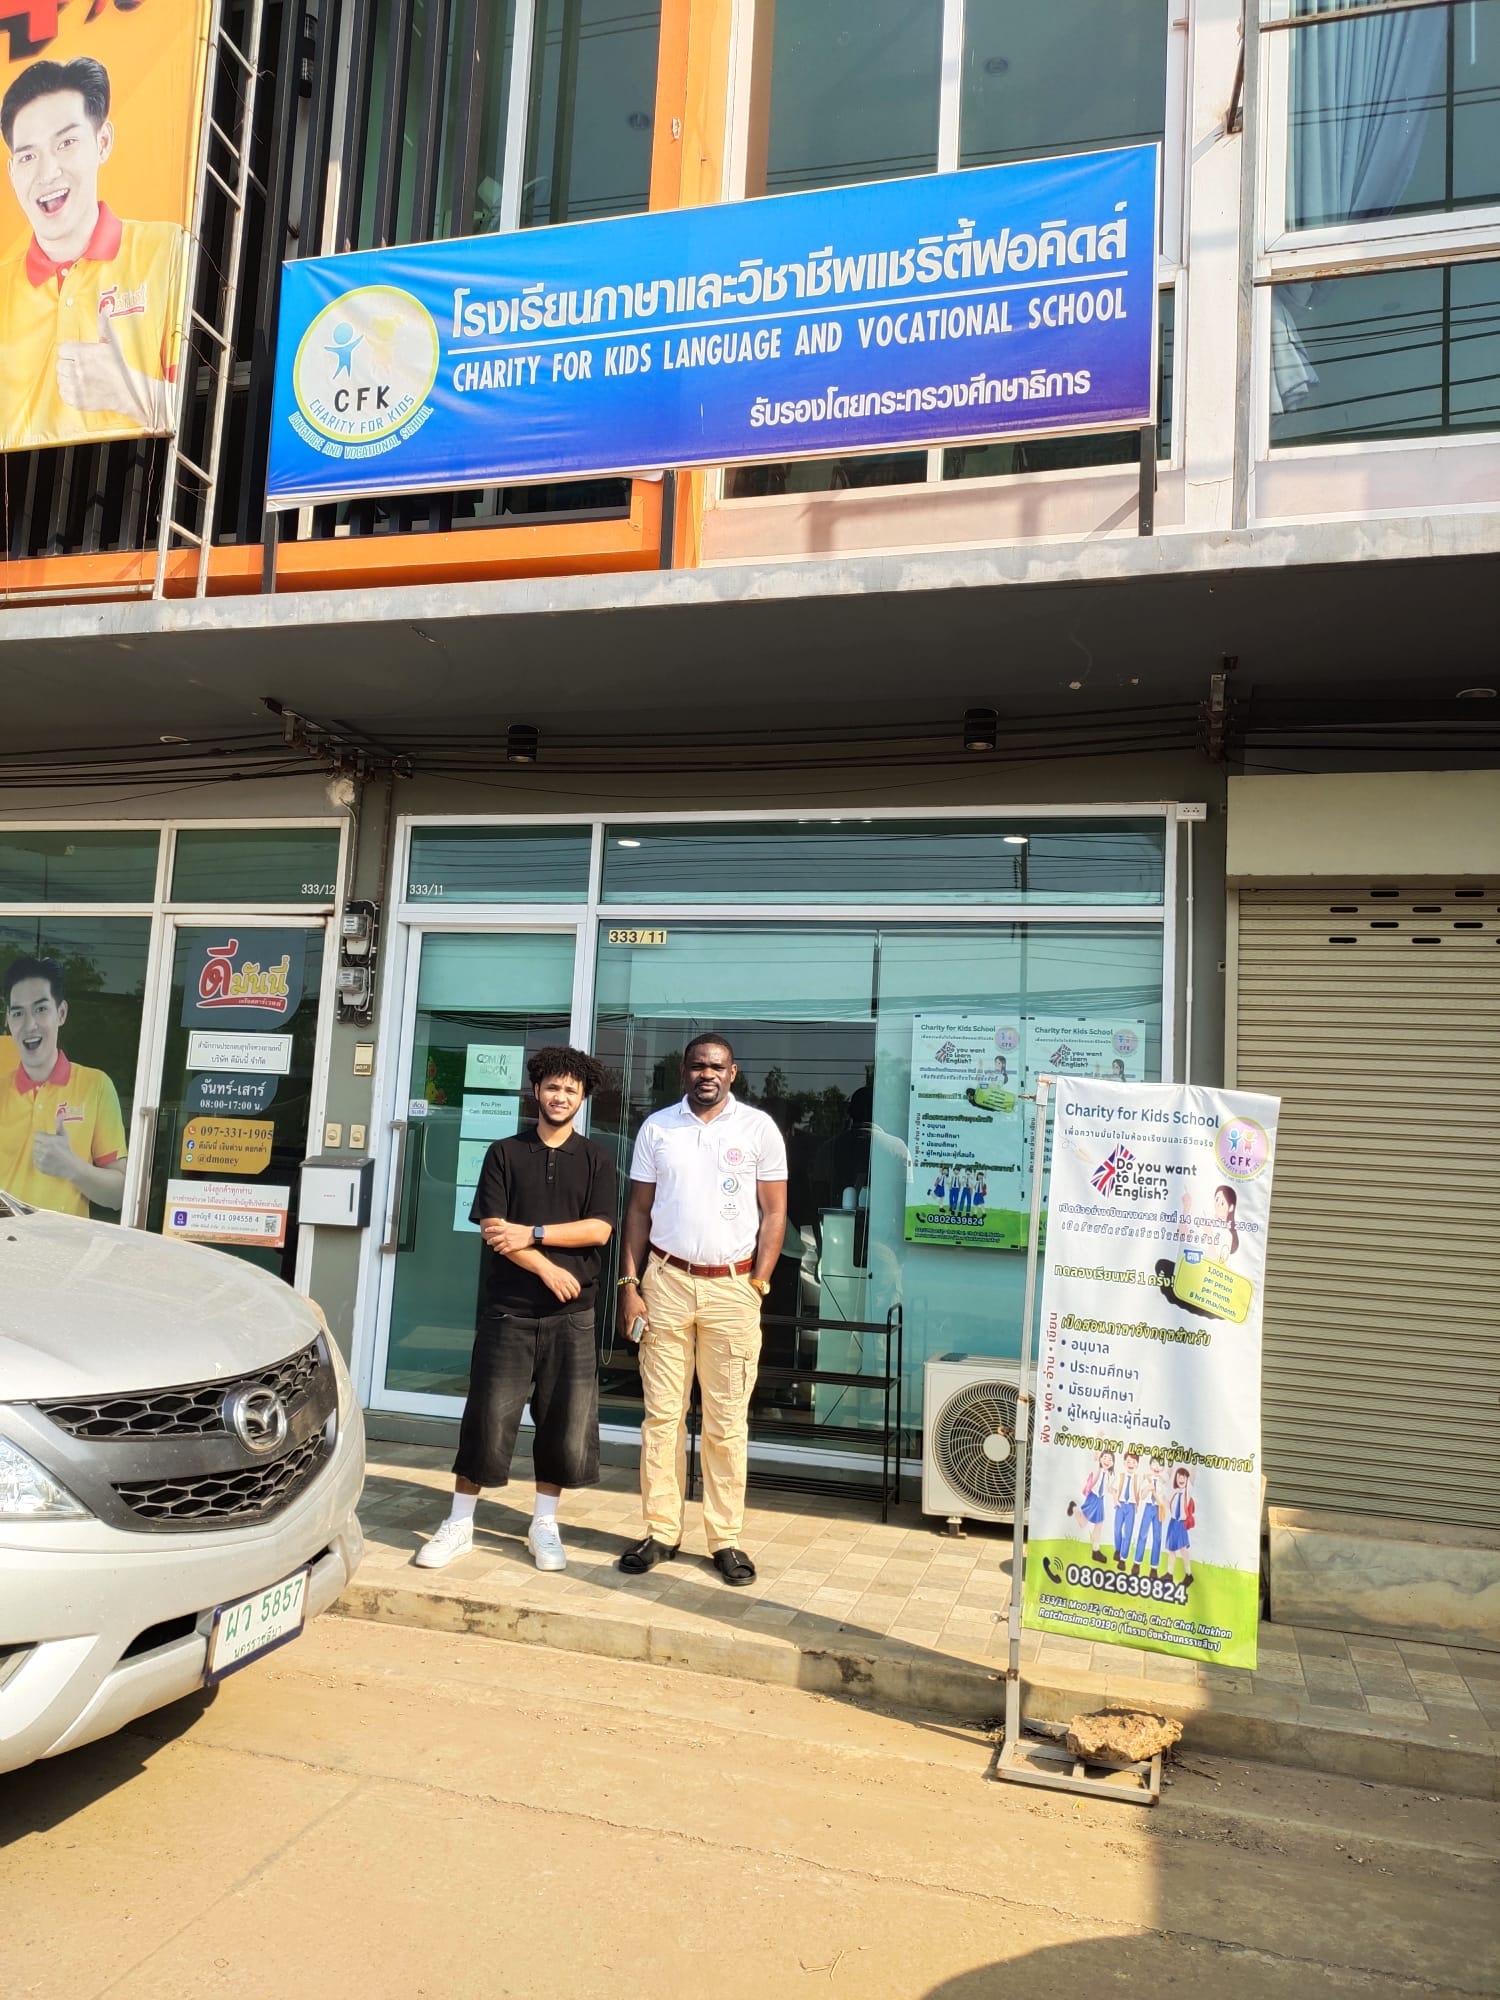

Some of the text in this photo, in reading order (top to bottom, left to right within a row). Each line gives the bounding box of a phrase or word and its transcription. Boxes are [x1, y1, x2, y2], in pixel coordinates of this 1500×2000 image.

[453, 201, 1127, 338] โรงเรียนภาษาและวิชาชีพแชริตี้ฟอคิดส์
[453, 287, 1127, 393] CHARITY FOR KIDS LANGUAGE AND VOCATIONAL SCHOOL
[334, 385, 390, 412] CFK
[750, 369, 1091, 428] รับรองโดยกระทรวงศึกษาธิการ
[309, 394, 415, 434] CHARITY FOR KIDS
[288, 405, 434, 459] LANGUAGE AND VOCATIONAL SCHOOL
[301, 883, 336, 896] 333/12
[409, 883, 444, 896] 333/11
[609, 930, 666, 944] 333/11
[921, 1024, 945, 1032] Charity
[1034, 1027, 1060, 1035] Charity
[201, 1078, 267, 1097] จันทร์-เสาร์
[200, 1099, 263, 1111] 08:00-17:00 น.
[1065, 1103, 1219, 1128] Charity for Kids School
[200, 1126, 273, 1140] 097-331-1905
[198, 1153, 239, 1167] @dmoney
[1116, 1158, 1197, 1176] Do you want
[1230, 1156, 1251, 1167] CFK
[1133, 1173, 1167, 1187] learn
[1115, 1185, 1169, 1201] English?
[214, 1214, 226, 1222] 411
[927, 1214, 984, 1226] 0802639824
[1234, 1222, 1259, 1233] 2569
[1054, 1264, 1175, 1288] ทดลองเรียนฟรี 1 ครั้ง!
[1207, 1266, 1234, 1283] 1,000 thb
[1203, 1277, 1233, 1293] per person
[1201, 1287, 1231, 1304] per month
[1195, 1293, 1205, 1303] hrs
[1206, 1298, 1236, 1318] max/month
[1061, 1314, 1212, 1346] เปิดสอนภาษาอังกฤษสำหรับ
[1071, 1340, 1110, 1355] อนุบาล
[1040, 1312, 1058, 1444] ฟัง พูด อ่าน เขียน
[1070, 1360, 1139, 1380] ประถมศึกษา
[1068, 1381, 1134, 1403] มัธยมศึกษา
[1067, 1403, 1171, 1430] ผู้ใหญ่และผู้ที่สนใจ
[1053, 1425, 1123, 1454] เจ้าของภาษา
[1066, 1563, 1188, 1605] 0802639824
[261, 1577, 303, 1622] 5857
[1038, 1608, 1089, 1626] Ratchasima
[1089, 1618, 1117, 1631] 30190
[1040, 1594, 1232, 1639] 333/11 Moo 12, Chok Chai, Chok Chai, Nakhon
[234, 1625, 283, 1658] นครราชสีมา
